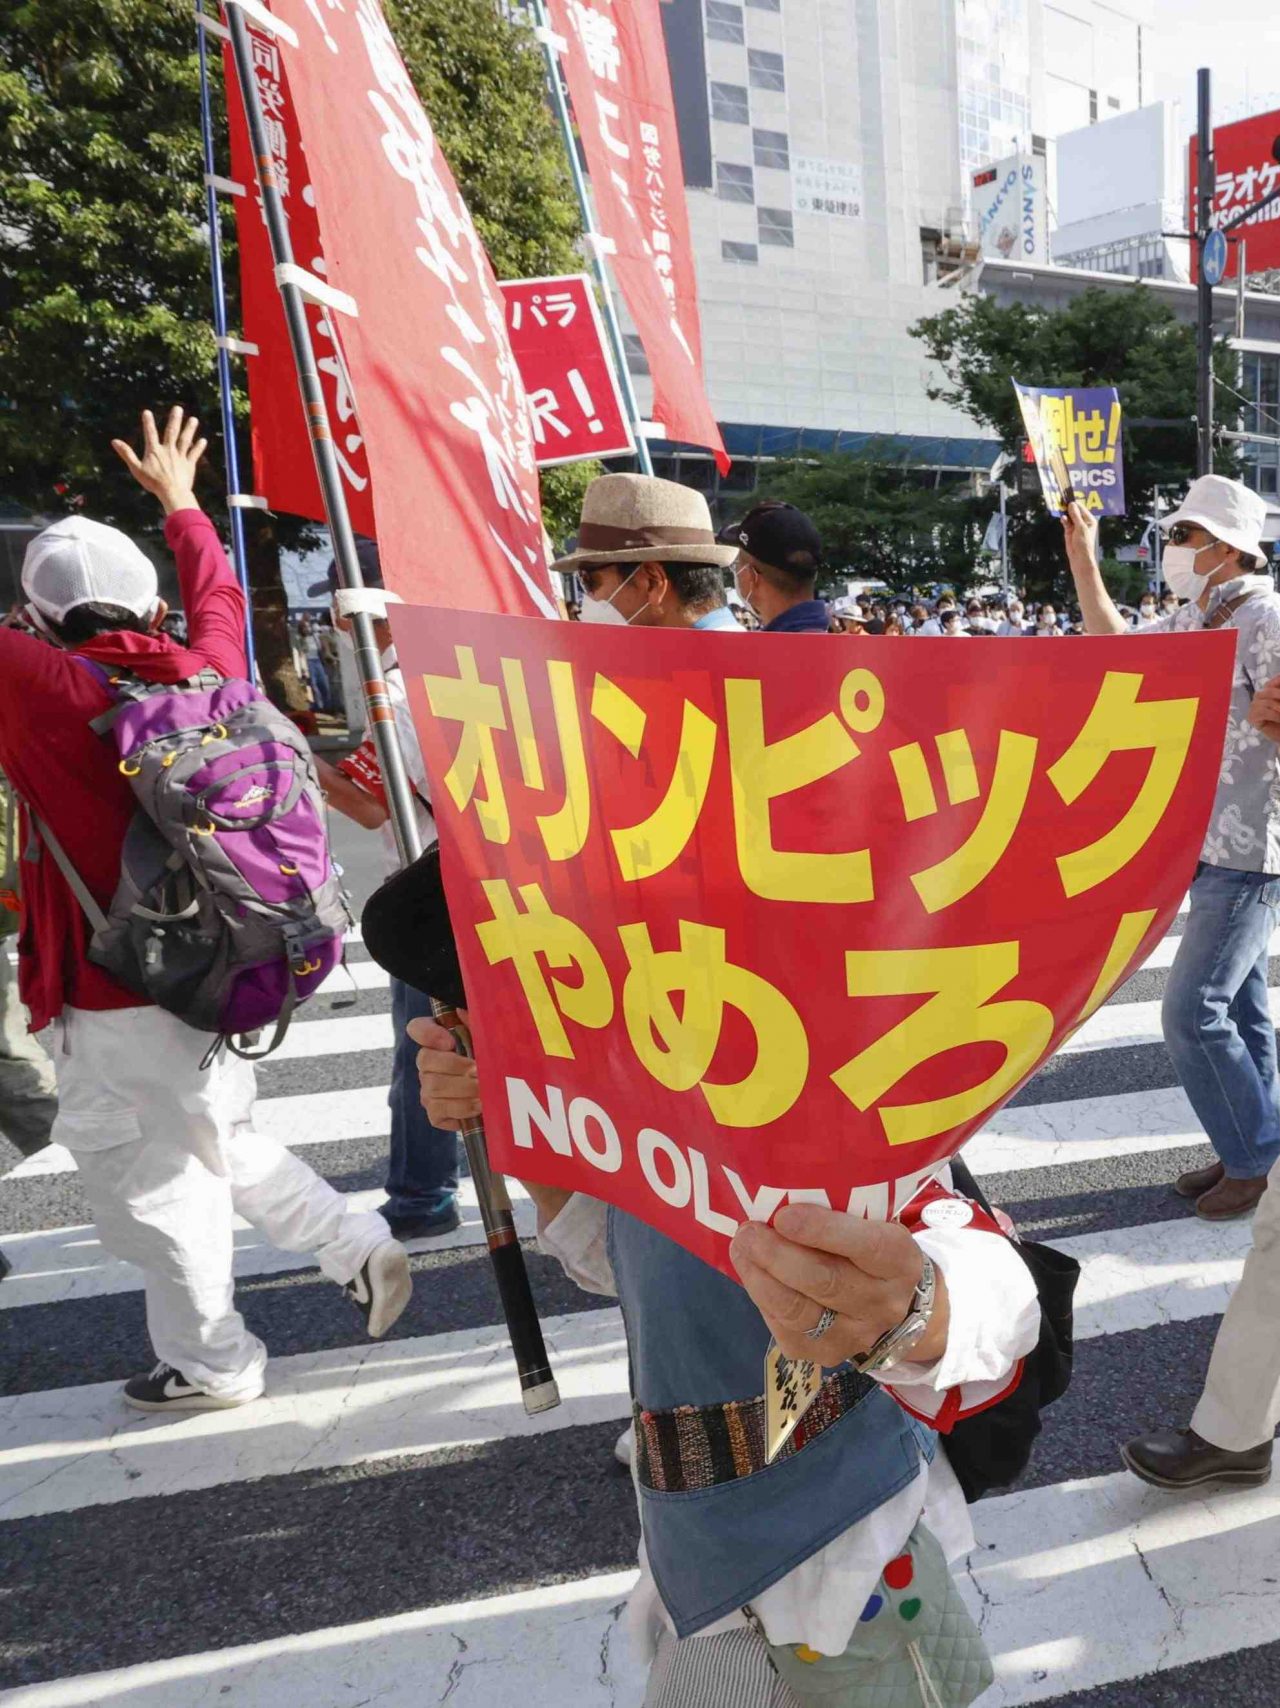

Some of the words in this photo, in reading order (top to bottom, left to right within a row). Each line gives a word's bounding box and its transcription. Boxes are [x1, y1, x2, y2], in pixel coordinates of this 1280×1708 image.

[1021, 164, 1037, 255] SANKYO
[422, 645, 1200, 914] オリンピック
[506, 1076, 623, 1173] NO
